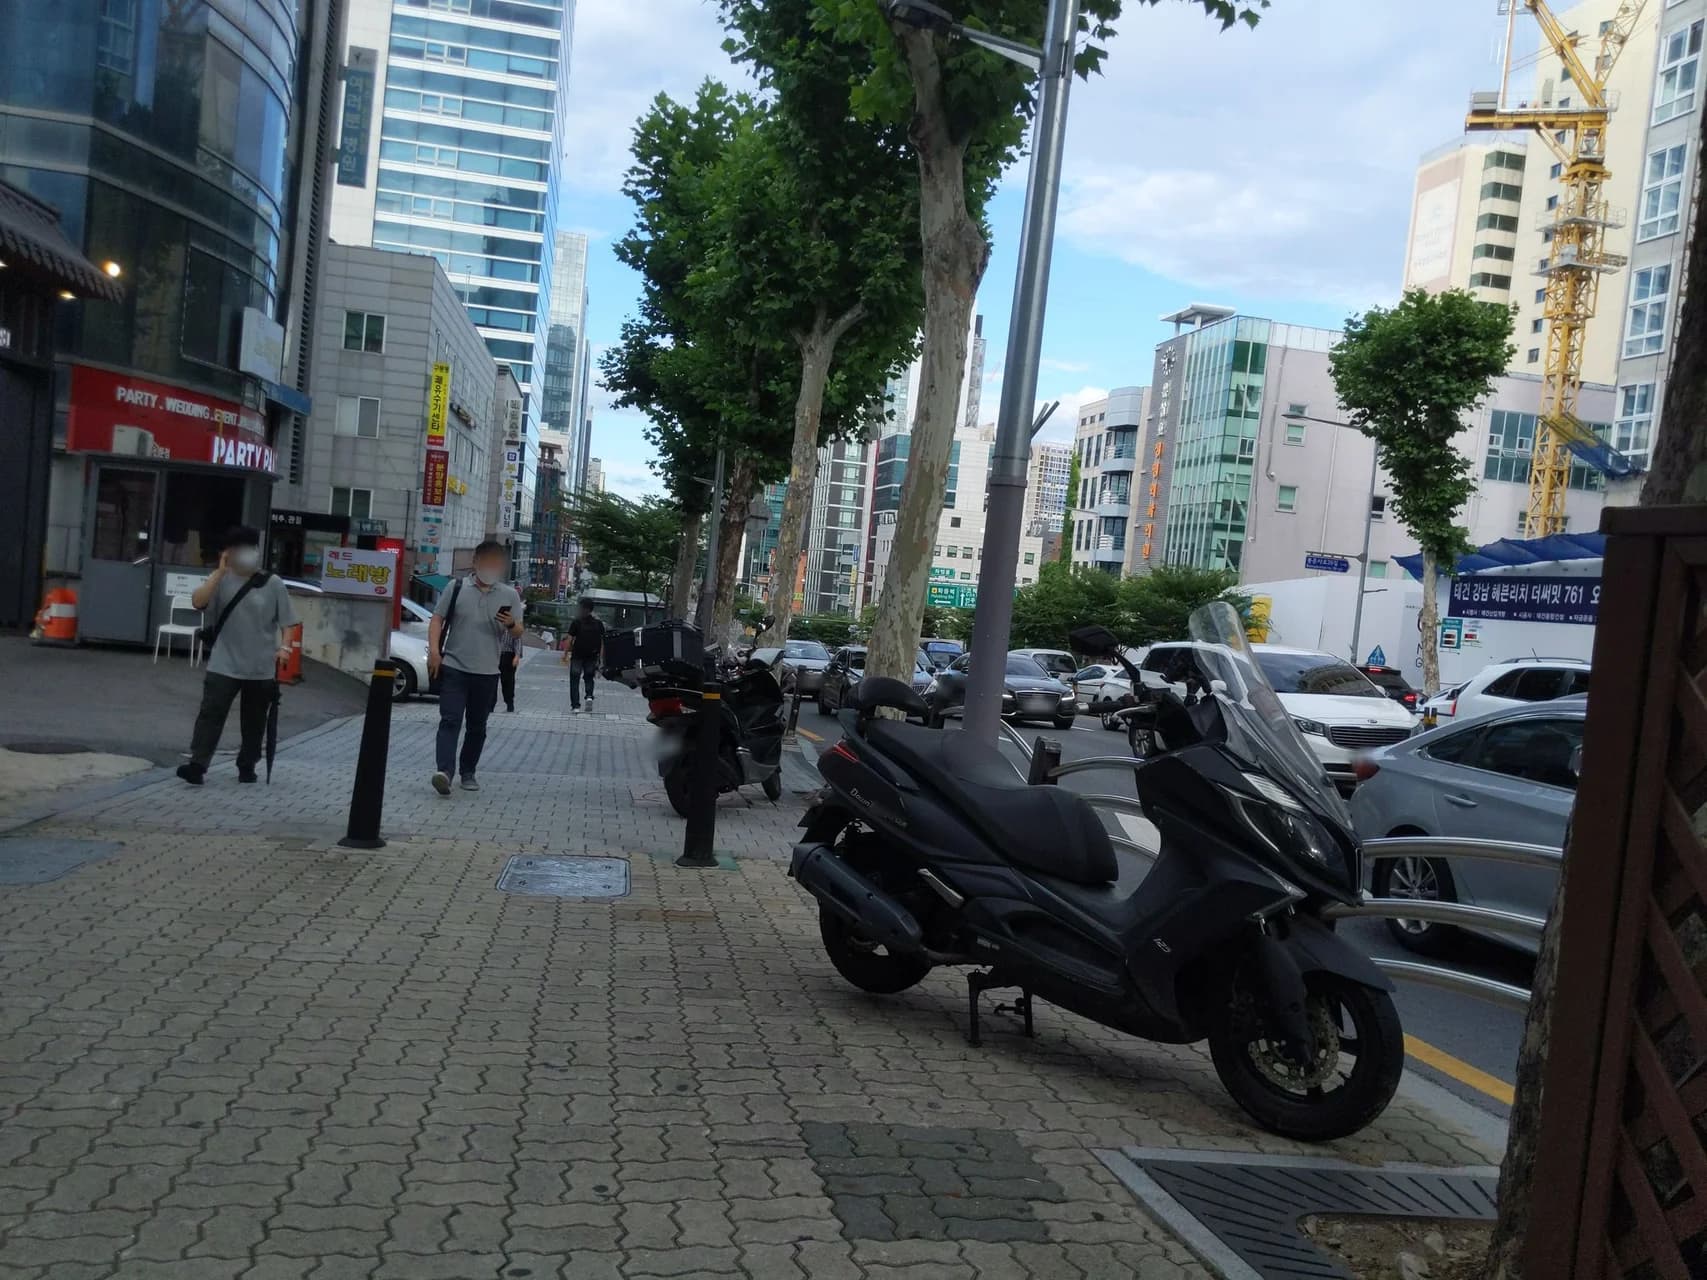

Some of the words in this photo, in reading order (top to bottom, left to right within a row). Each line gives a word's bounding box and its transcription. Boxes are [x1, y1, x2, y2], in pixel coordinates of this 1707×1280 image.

[116, 386, 159, 409] PARTY
[166, 397, 210, 420] WEDDING
[212, 436, 262, 469] PARTY
[328, 550, 353, 561] 레드
[324, 562, 391, 585] 노래방
[1454, 583, 1471, 601] 태건
[1472, 583, 1489, 602] 강남
[1491, 583, 1528, 604] 헤븐리치
[1531, 584, 1561, 605] 더써밋
[1564, 585, 1584, 604] 761
